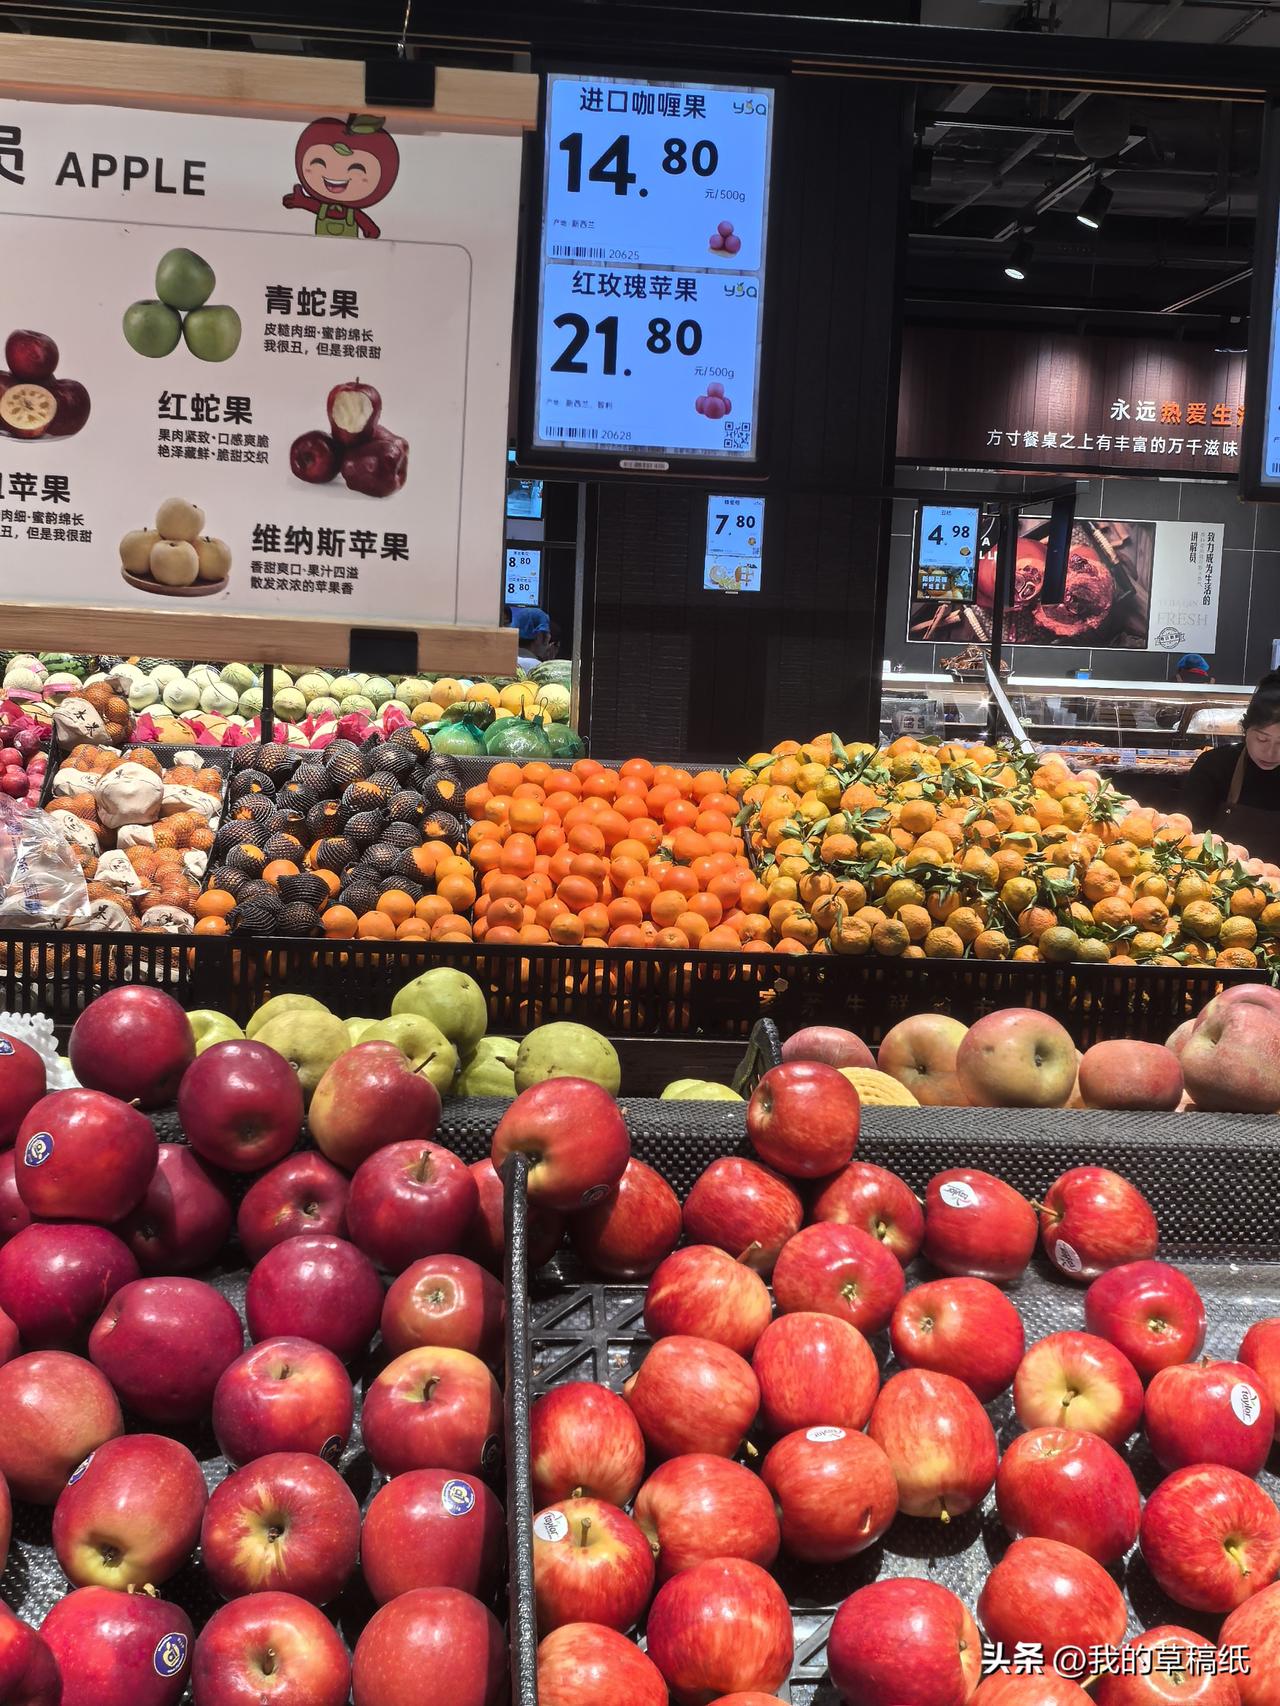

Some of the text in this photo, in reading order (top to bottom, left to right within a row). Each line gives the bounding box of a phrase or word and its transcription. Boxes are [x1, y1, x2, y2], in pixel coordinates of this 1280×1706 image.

[579, 87, 706, 119] 进口咖喱果
[661, 137, 719, 177] 80
[55, 151, 207, 196] APPLE
[704, 187, 746, 202] 元/500g
[608, 249, 640, 260] 20625
[265, 284, 359, 319] 青蛇果
[571, 271, 698, 302] 红玫瑰苹果
[263, 339, 382, 360] 我很丑，但是我很甜
[646, 317, 703, 356] 80
[694, 365, 735, 380] 元/500g
[158, 390, 253, 425] 红蛇果
[158, 428, 270, 448] 果肉紧致·口感爽脆
[600, 430, 632, 441] 20628
[986, 428, 1239, 458] 方寸餐桌之上有丰富的万千滋味
[0, 471, 71, 504] 苹果
[736, 515, 756, 528] 80
[952, 525, 970, 538] 98
[251, 523, 409, 561] 维纳斯苹果
[250, 560, 359, 579] 香甜爽口·果汁四溢
[1202, 531, 1215, 606] 致力成为生活的
[250, 575, 354, 595] 散发浓浓的苹果香
